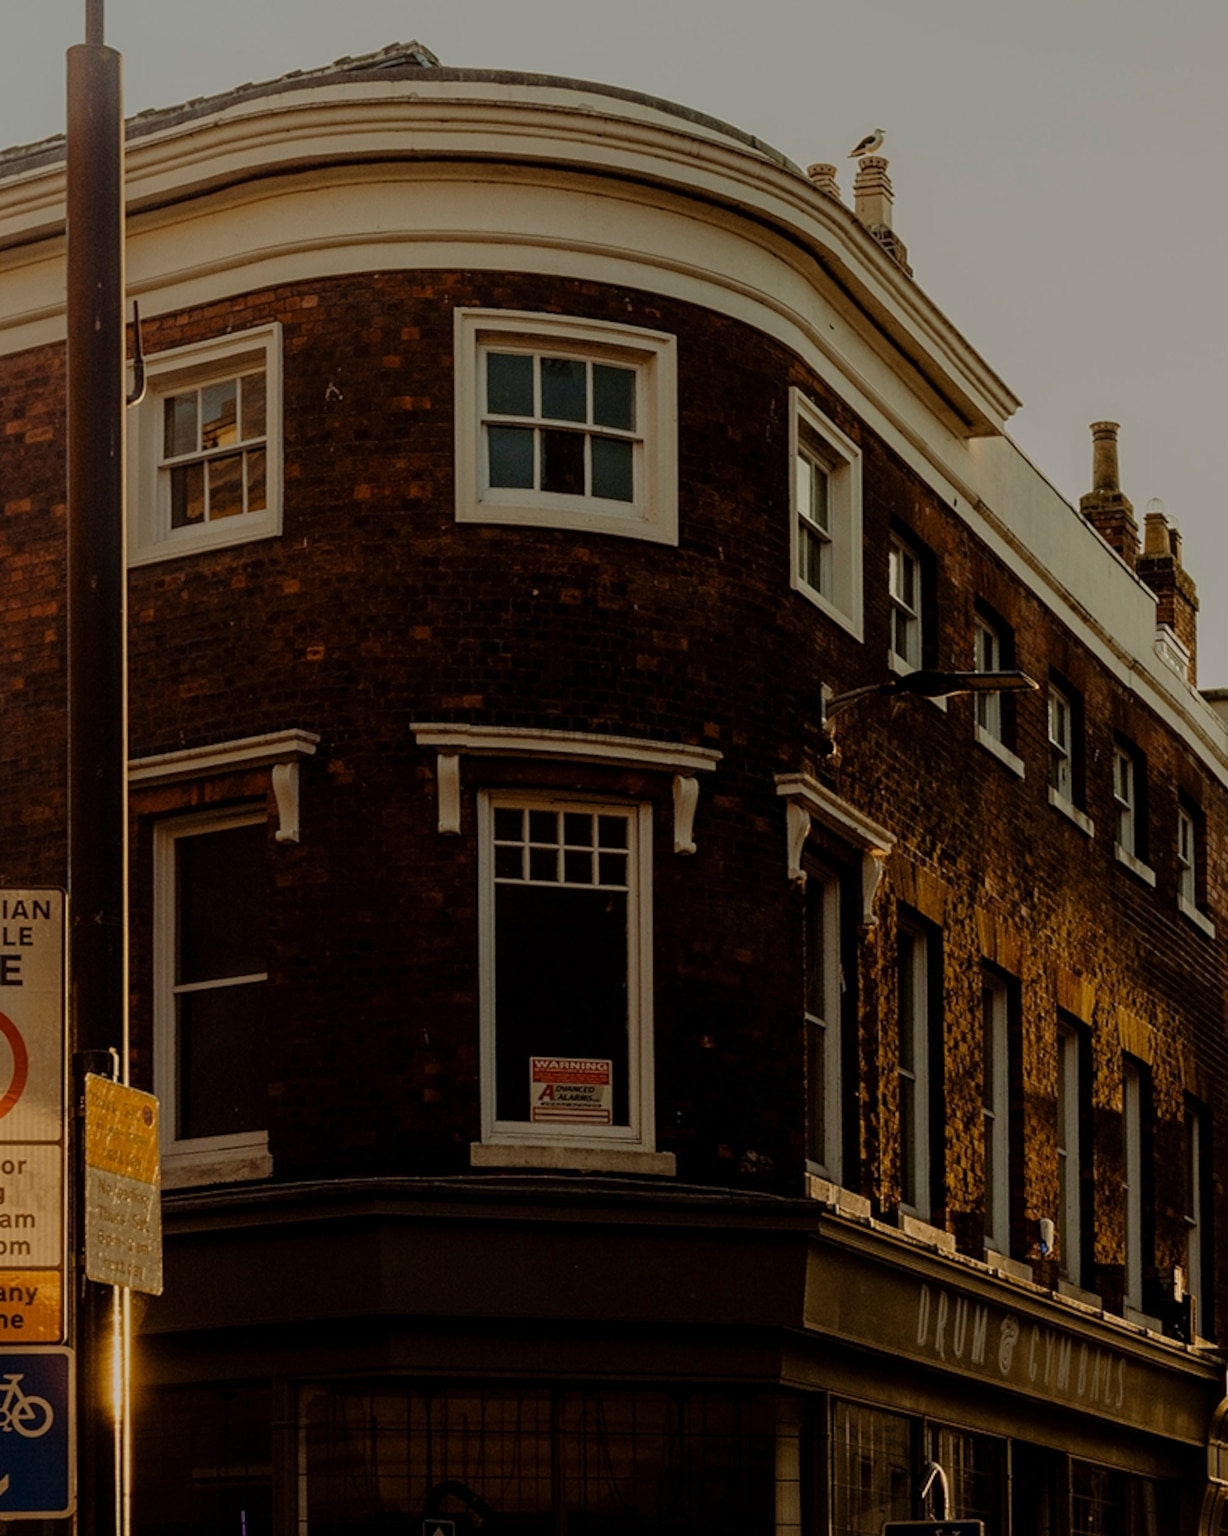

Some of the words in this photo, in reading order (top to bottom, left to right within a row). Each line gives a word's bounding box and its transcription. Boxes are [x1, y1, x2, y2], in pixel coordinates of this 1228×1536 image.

[534, 1060, 608, 1070] WARNING
[916, 1282, 988, 1366] DRUM
[1028, 1322, 1127, 1411] CYMBALS
